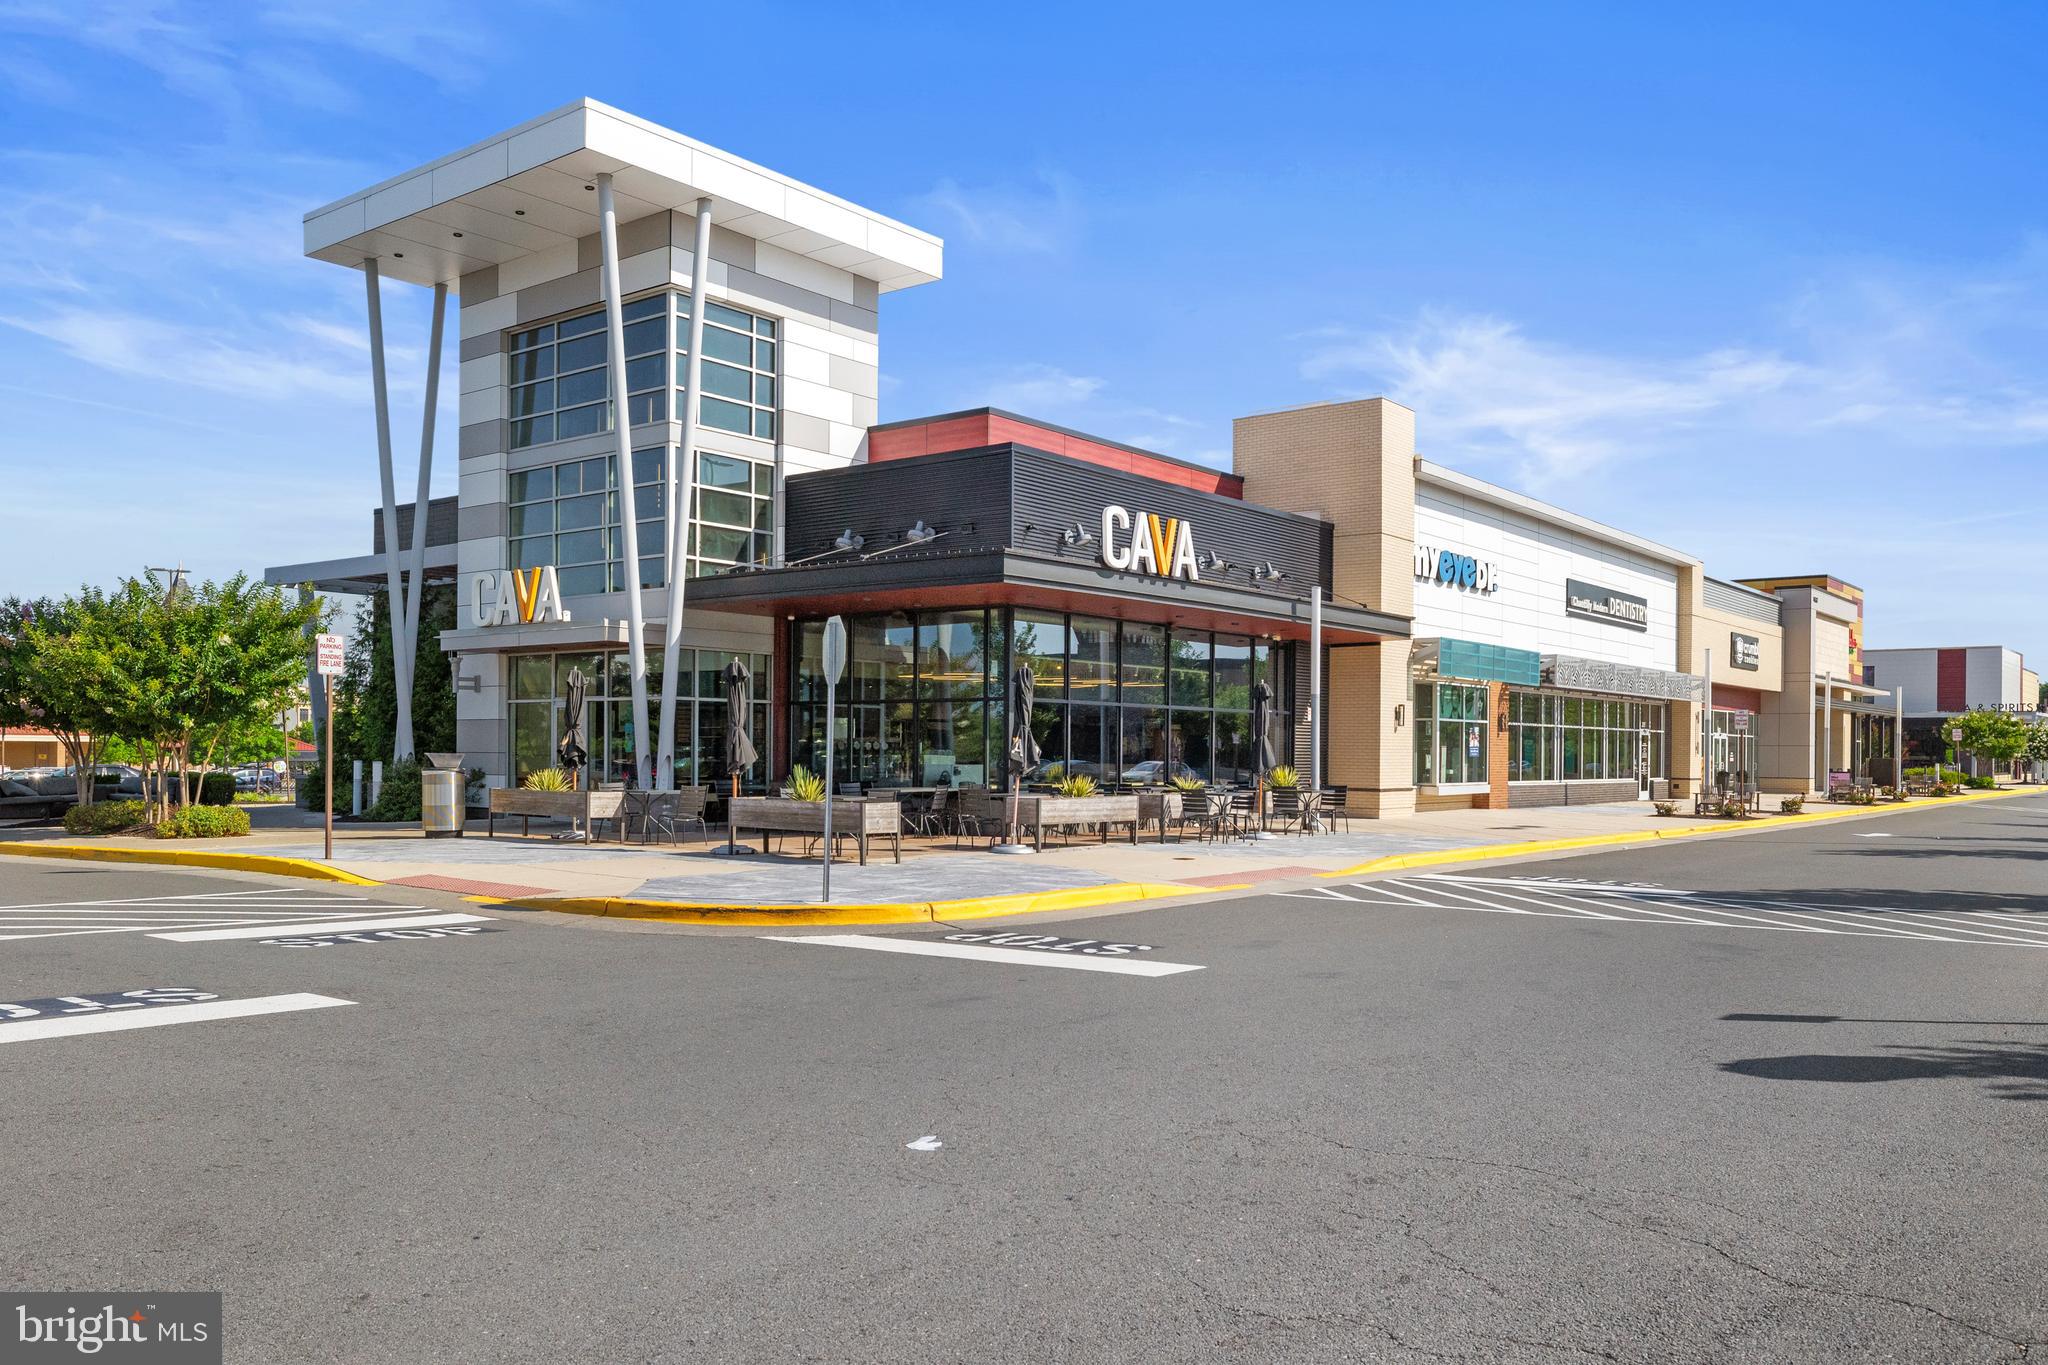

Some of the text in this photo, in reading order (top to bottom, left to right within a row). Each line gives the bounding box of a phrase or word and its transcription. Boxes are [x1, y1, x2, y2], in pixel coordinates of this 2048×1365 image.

[1101, 504, 1199, 582] CAVA
[471, 565, 563, 627] CAVA
[1609, 597, 1647, 622] DENTISTRY
[1990, 703, 2034, 713] SPIRITS
[258, 926, 484, 948] STOP
[944, 932, 1152, 955] STOP
